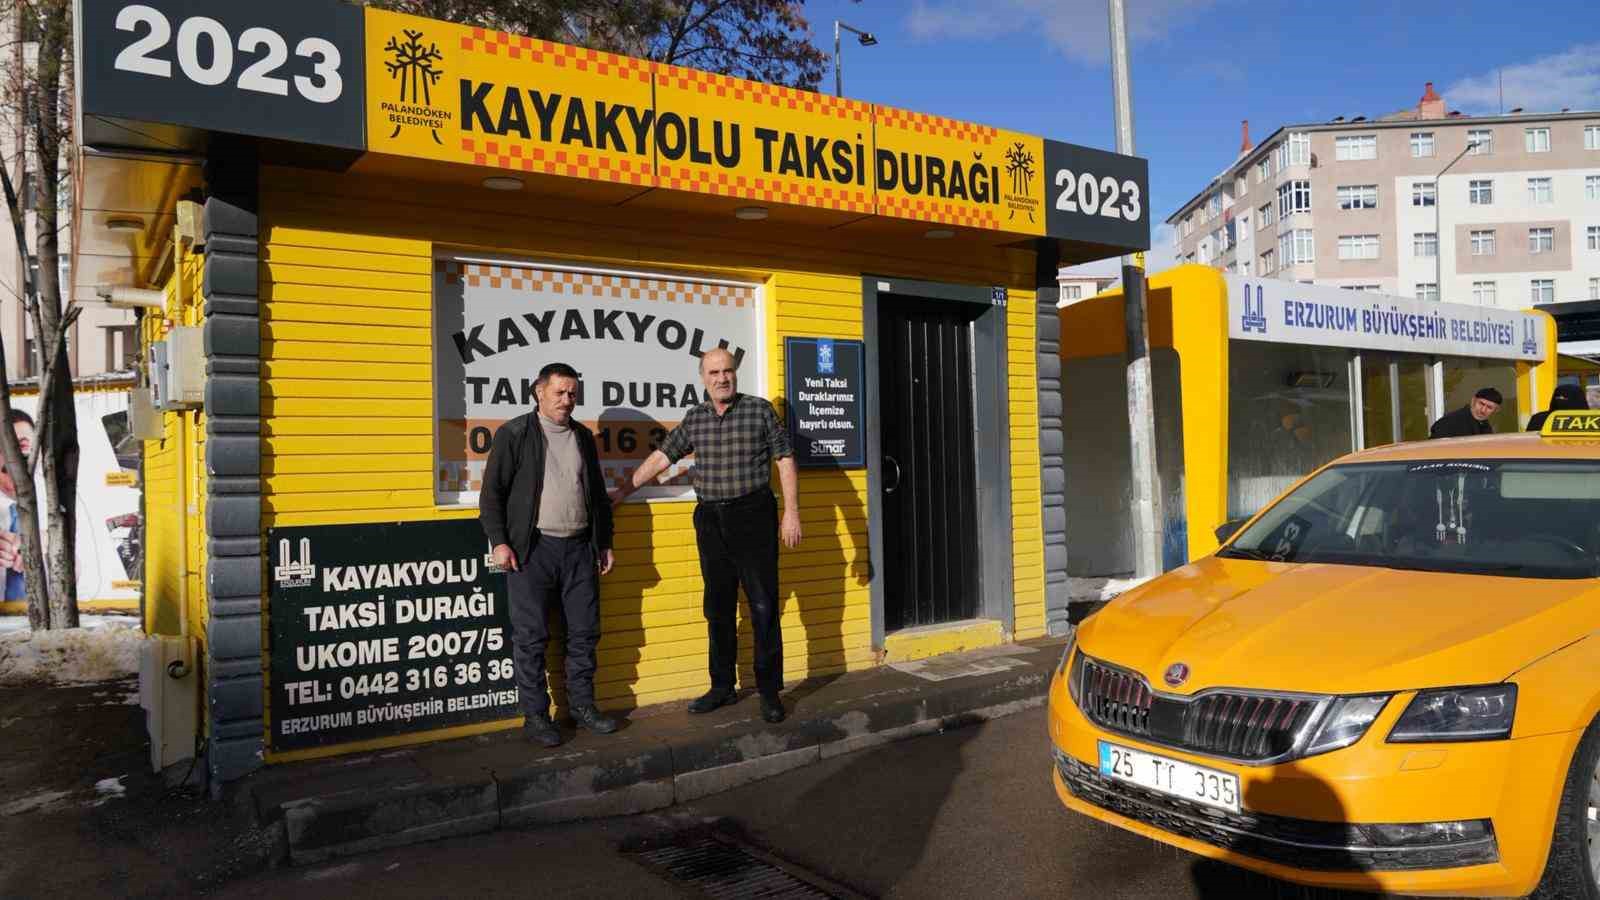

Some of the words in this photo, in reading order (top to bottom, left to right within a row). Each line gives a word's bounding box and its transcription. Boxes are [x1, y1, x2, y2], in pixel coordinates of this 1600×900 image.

[115, 5, 343, 103] 2023
[381, 102, 452, 120] PALANDÖKEN
[460, 79, 740, 168] KAYAKYOLU
[755, 127, 864, 185] TAKSİ
[876, 149, 999, 204] DURAĞI
[1055, 168, 1141, 222] 2023
[1285, 300, 1357, 331] ERZURUM
[1362, 304, 1447, 341] BÜYÜKŞEHİR
[1451, 317, 1514, 345] BELEDİYESİ
[602, 381, 709, 409] DURA
[799, 391, 854, 402] Duraklarımız
[805, 378, 823, 388] Yeni
[825, 378, 847, 389] Taksi
[1556, 416, 1600, 429] TAK
[323, 558, 477, 592] KAYAKYOLU
[304, 595, 385, 632] TAKSİ
[396, 587, 494, 624] DURAĞI
[297, 638, 400, 672] UKOME
[408, 628, 503, 660] 2007/5
[285, 680, 332, 705] TEL:
[340, 671, 399, 700] 0442
[406, 665, 447, 691] 316
[454, 661, 481, 685] 36
[488, 658, 514, 680] 36
[281, 712, 352, 735] ERZURUM
[357, 699, 444, 722] BÜYÜKŞEHİR
[447, 686, 519, 713] BELEDİYESİ
[1111, 750, 1134, 777] 25
[1194, 771, 1234, 805] 335
